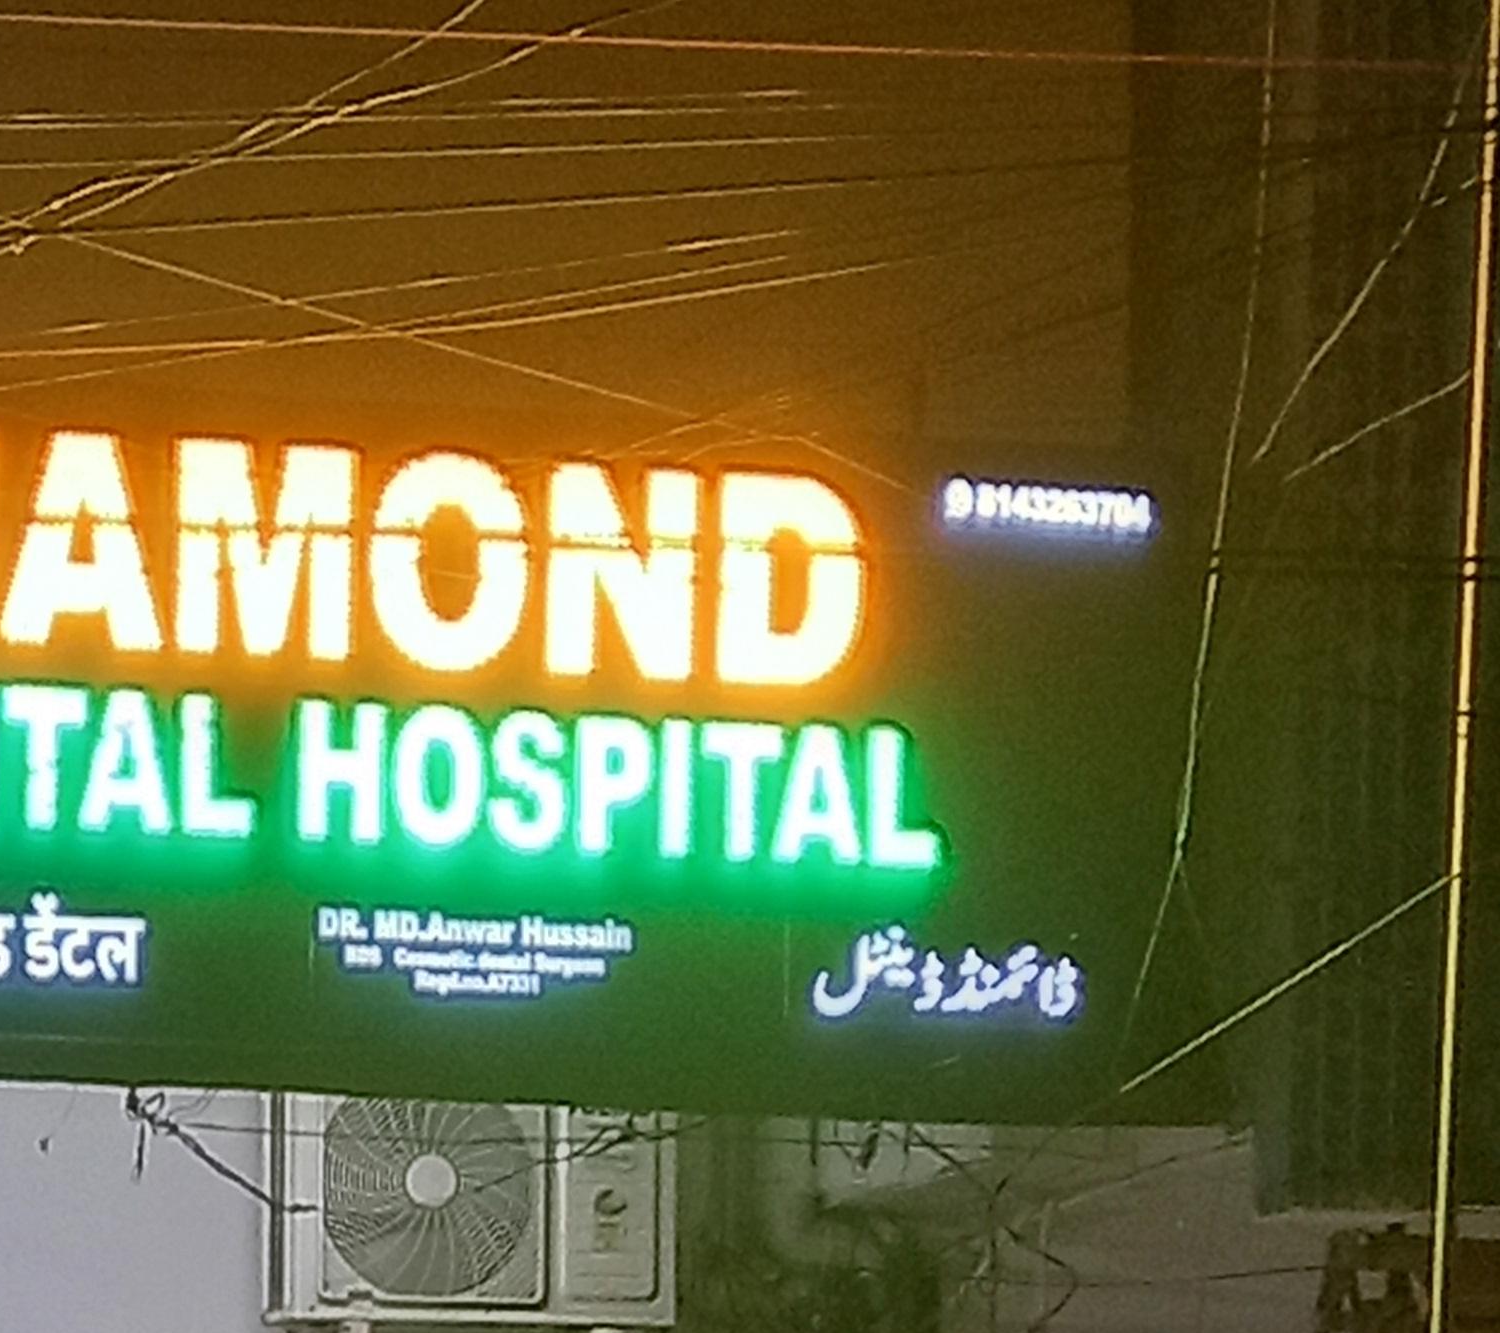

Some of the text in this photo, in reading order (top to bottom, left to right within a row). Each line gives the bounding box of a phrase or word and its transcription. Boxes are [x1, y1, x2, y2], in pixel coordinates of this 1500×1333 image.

[298, 698, 940, 870] HOSPITAL
[317, 905, 369, 941] DR.
[520, 915, 635, 952] Hussain
